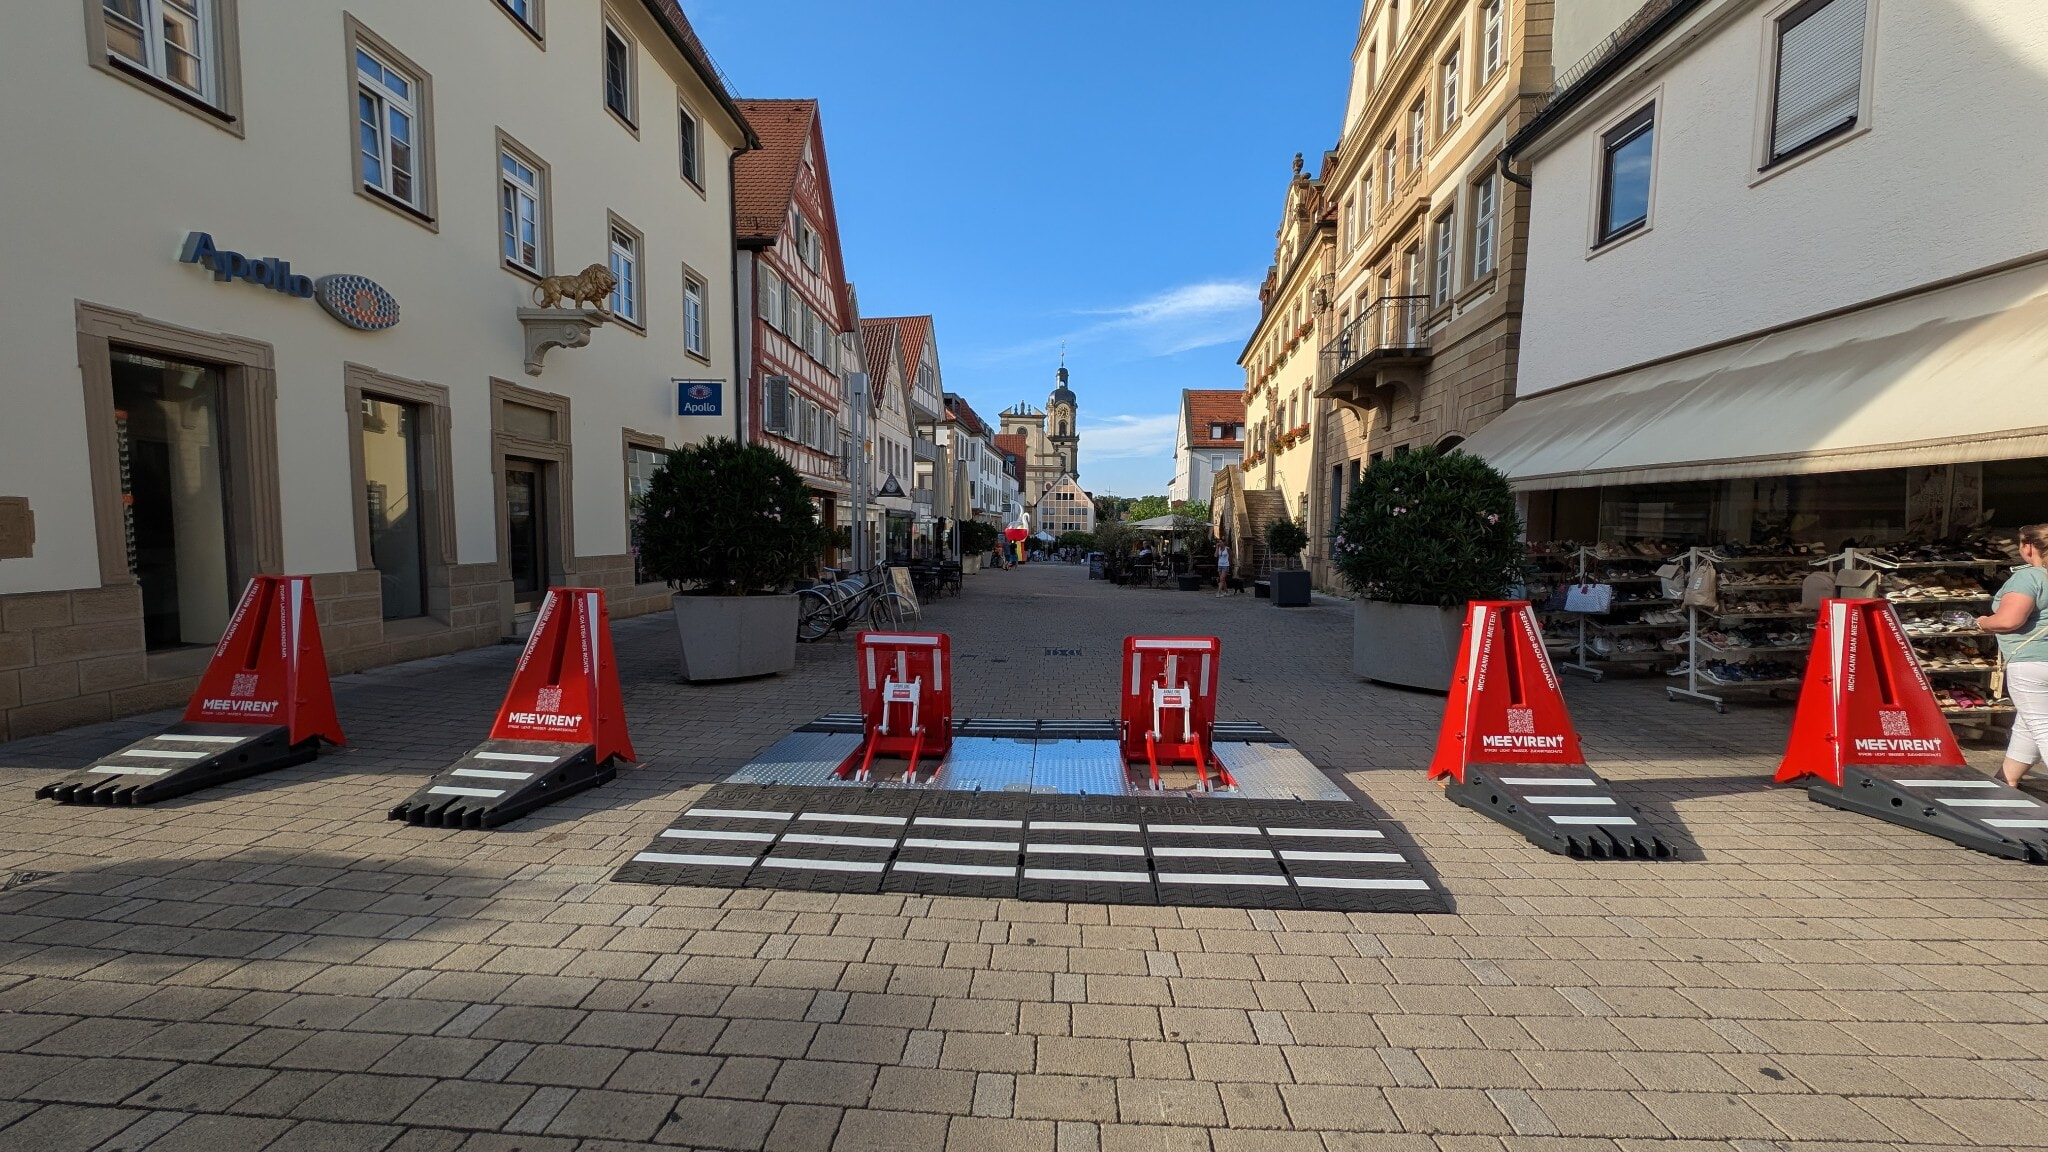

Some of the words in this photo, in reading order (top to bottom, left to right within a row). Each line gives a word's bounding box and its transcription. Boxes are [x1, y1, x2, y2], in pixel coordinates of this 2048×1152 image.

[180, 232, 313, 298] Apollo
[684, 402, 716, 414] Apollo
[1486, 611, 1497, 637] MIETEN!
[1850, 609, 1858, 636] MIETEN!
[1483, 638, 1492, 653] MAN
[1518, 610, 1556, 690] GEHWEG-BODYGUARD.
[1882, 609, 1896, 631] HUPEN
[1894, 631, 1906, 650] HILFT
[1903, 650, 1914, 667] HIER
[1912, 666, 1927, 691] NICHTS
[1480, 654, 1489, 673] KANN
[1477, 674, 1486, 691] MICH
